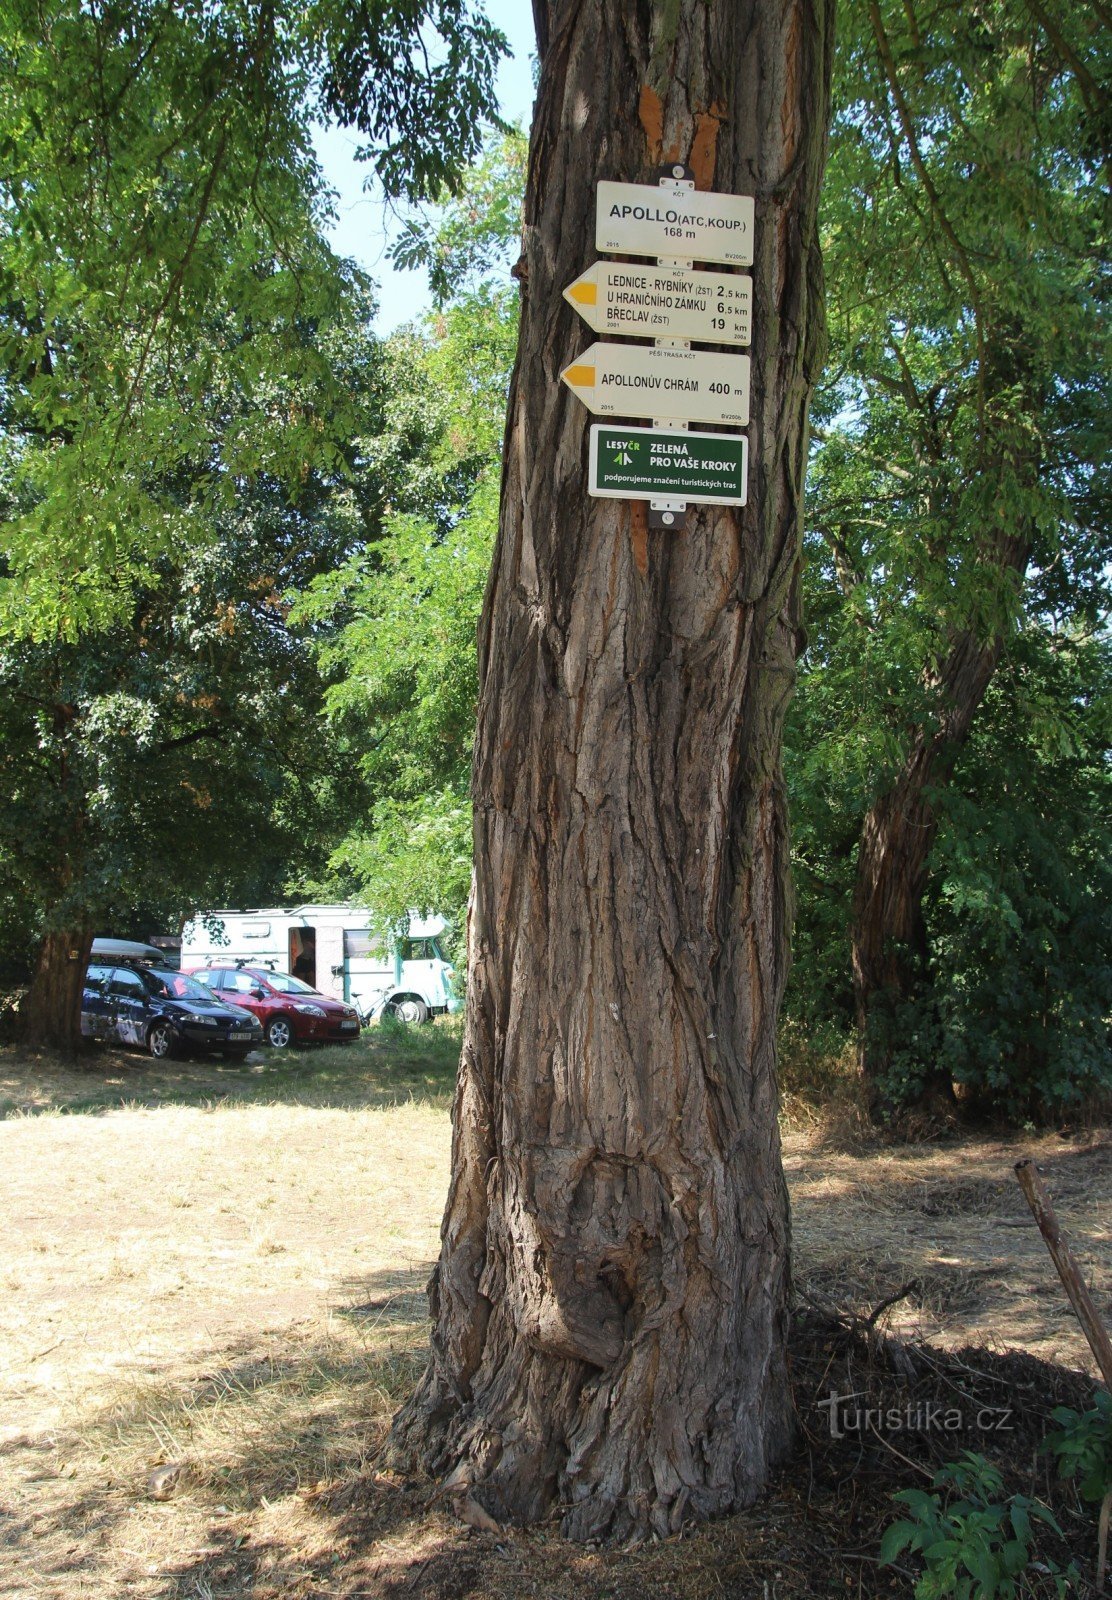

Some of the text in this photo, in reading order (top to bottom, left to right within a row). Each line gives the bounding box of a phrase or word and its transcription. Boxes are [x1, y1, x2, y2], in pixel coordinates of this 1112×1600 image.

[664, 226, 696, 239] 168 m
[608, 274, 647, 289] LEDNICE
[654, 278, 694, 294] RYBNÍKY
[696, 284, 713, 297] (ŽST)
[735, 290, 748, 300] km
[607, 290, 614, 302] U
[616, 292, 673, 308] HRANIČNÍHO
[674, 296, 706, 312] ZÁMKU
[734, 307, 748, 316] km
[607, 306, 747, 332] BŘECLAV (ŽST) 19 km
[602, 374, 662, 389] APOLLONŮV
[664, 378, 699, 392] CHRÁM
[708, 382, 730, 395] 400
[650, 444, 688, 456] ZELENÁ
[650, 456, 737, 472] PRO VAŠE KROKY
[604, 474, 652, 486] podporujeme
[654, 478, 680, 486] značení
[682, 478, 722, 489] turistických
